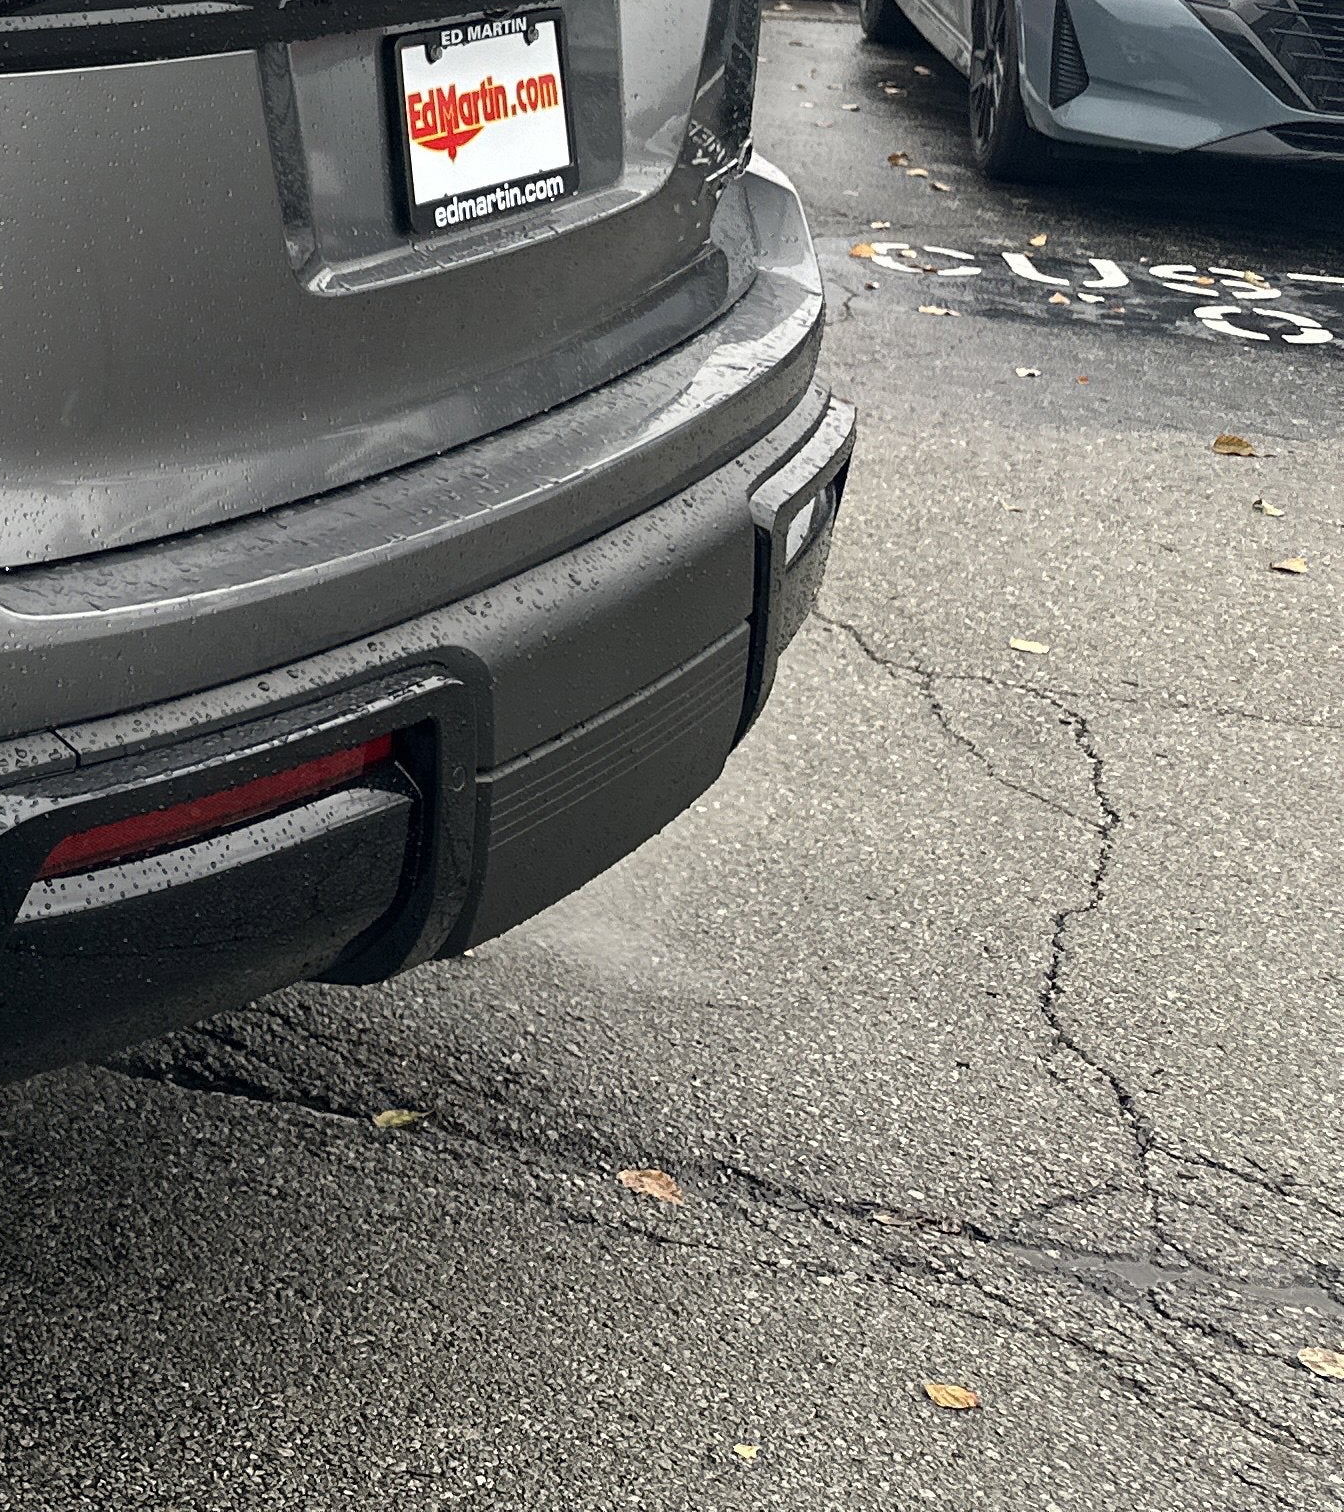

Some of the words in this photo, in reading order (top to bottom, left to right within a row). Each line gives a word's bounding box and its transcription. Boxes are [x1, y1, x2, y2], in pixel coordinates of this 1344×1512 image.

[441, 28, 463, 47] ED
[467, 16, 527, 42] MARTIN
[407, 72, 559, 144] EdMartin.com
[434, 173, 564, 229] edmartin.com
